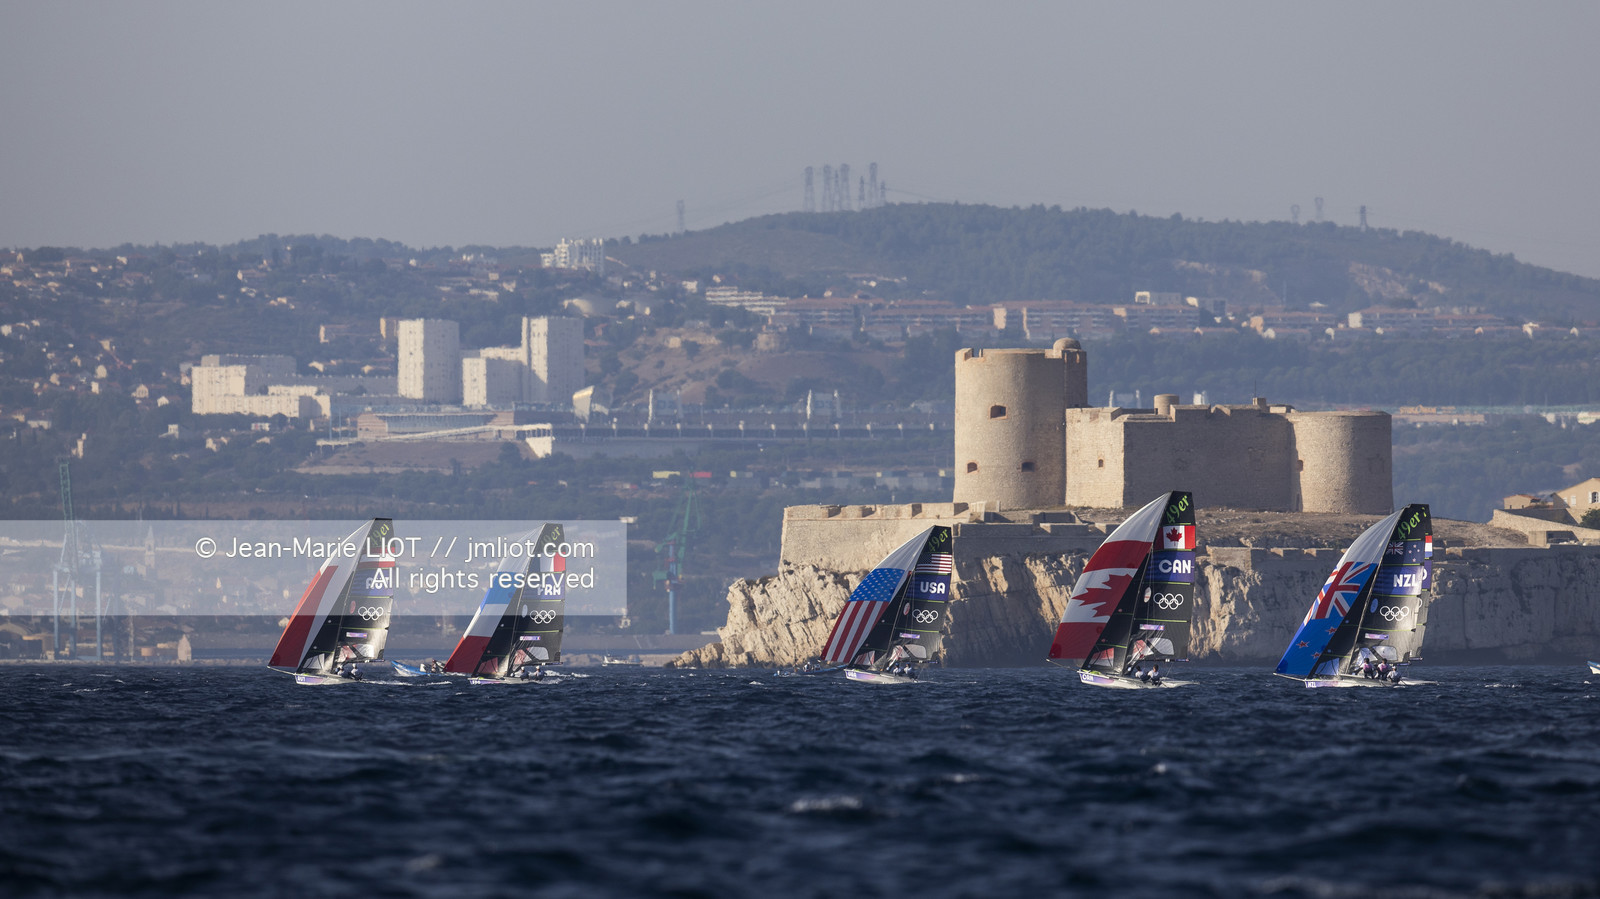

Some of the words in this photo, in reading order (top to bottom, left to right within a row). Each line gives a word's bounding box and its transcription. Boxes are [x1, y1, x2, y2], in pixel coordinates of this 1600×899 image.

[1166, 495, 1189, 524] 49er
[1397, 511, 1421, 541] 49er
[928, 529, 949, 552] 49er
[1158, 559, 1192, 574] CAN
[920, 581, 946, 595] USA
[1393, 573, 1419, 588] NZL
